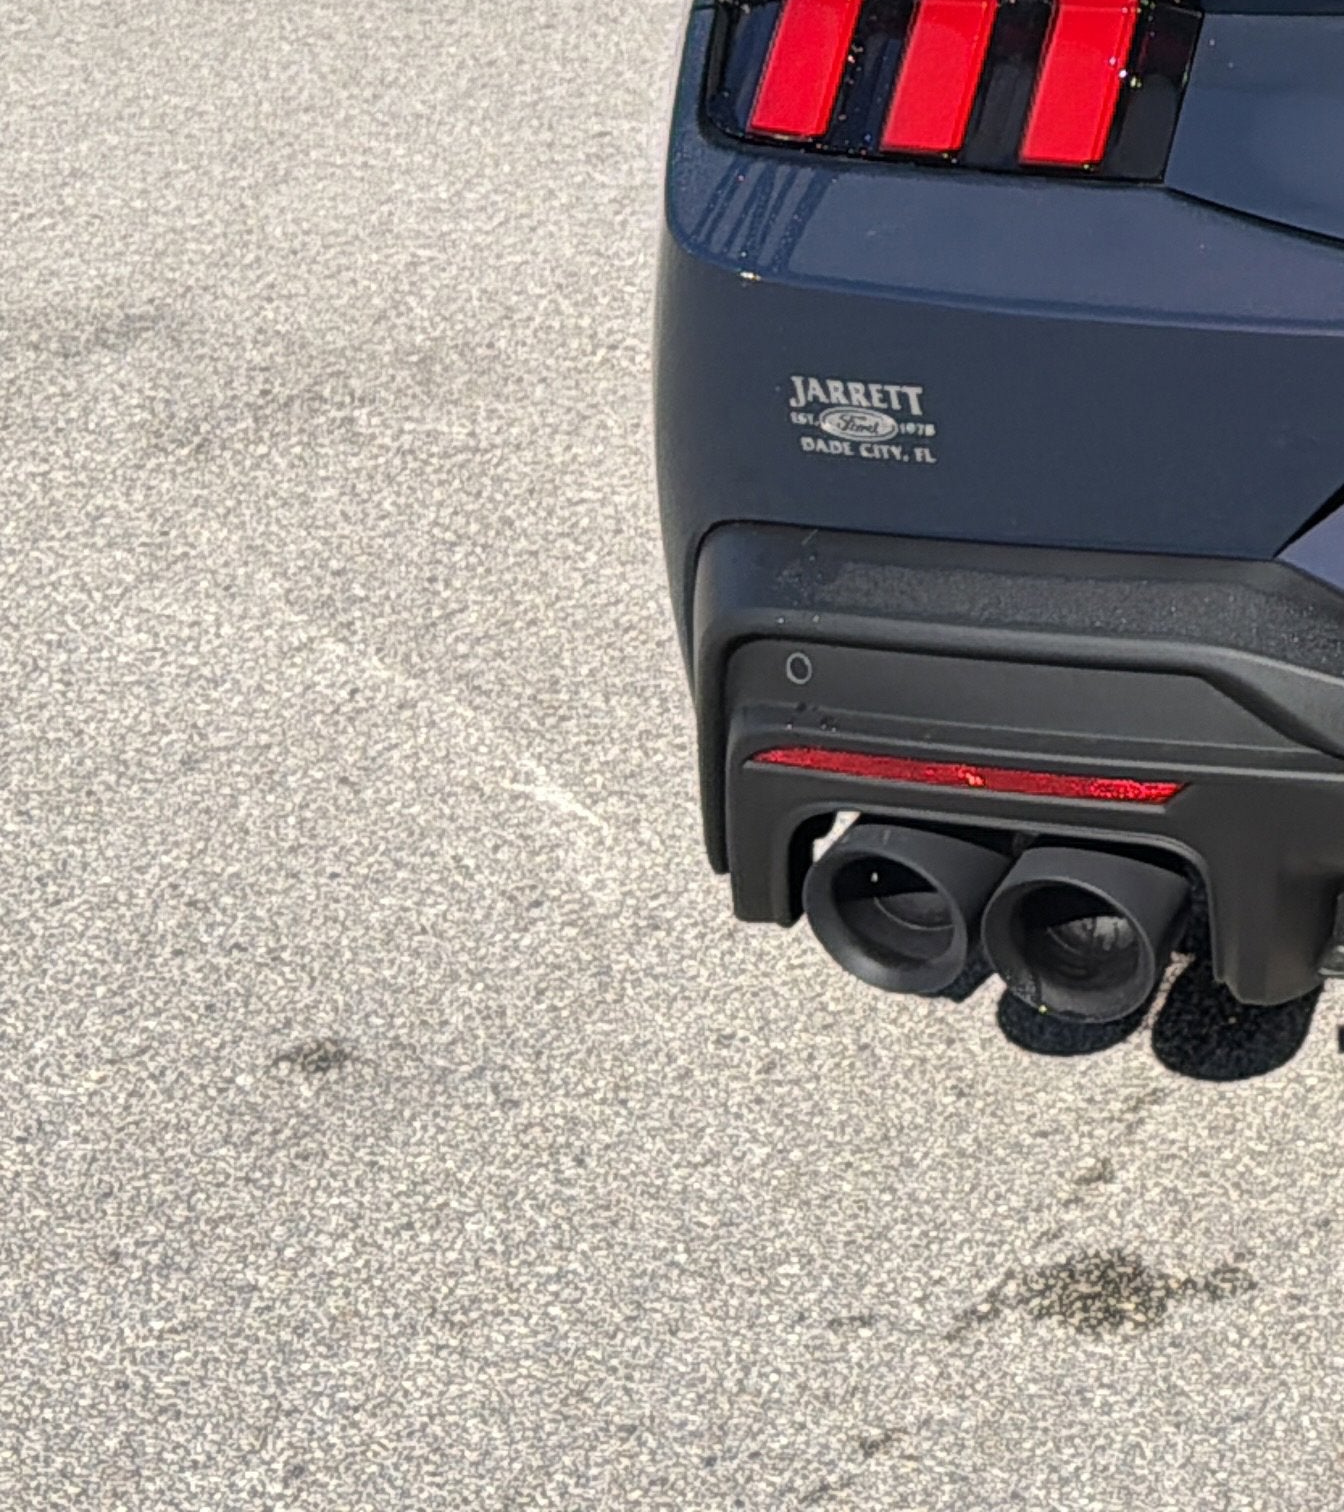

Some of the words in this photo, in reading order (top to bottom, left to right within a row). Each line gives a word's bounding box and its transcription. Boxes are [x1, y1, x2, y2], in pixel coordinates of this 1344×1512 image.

[789, 375, 923, 416] JARRETT
[836, 413, 881, 435] Ford
[800, 436, 855, 456] DADE
[913, 447, 937, 463] FL
